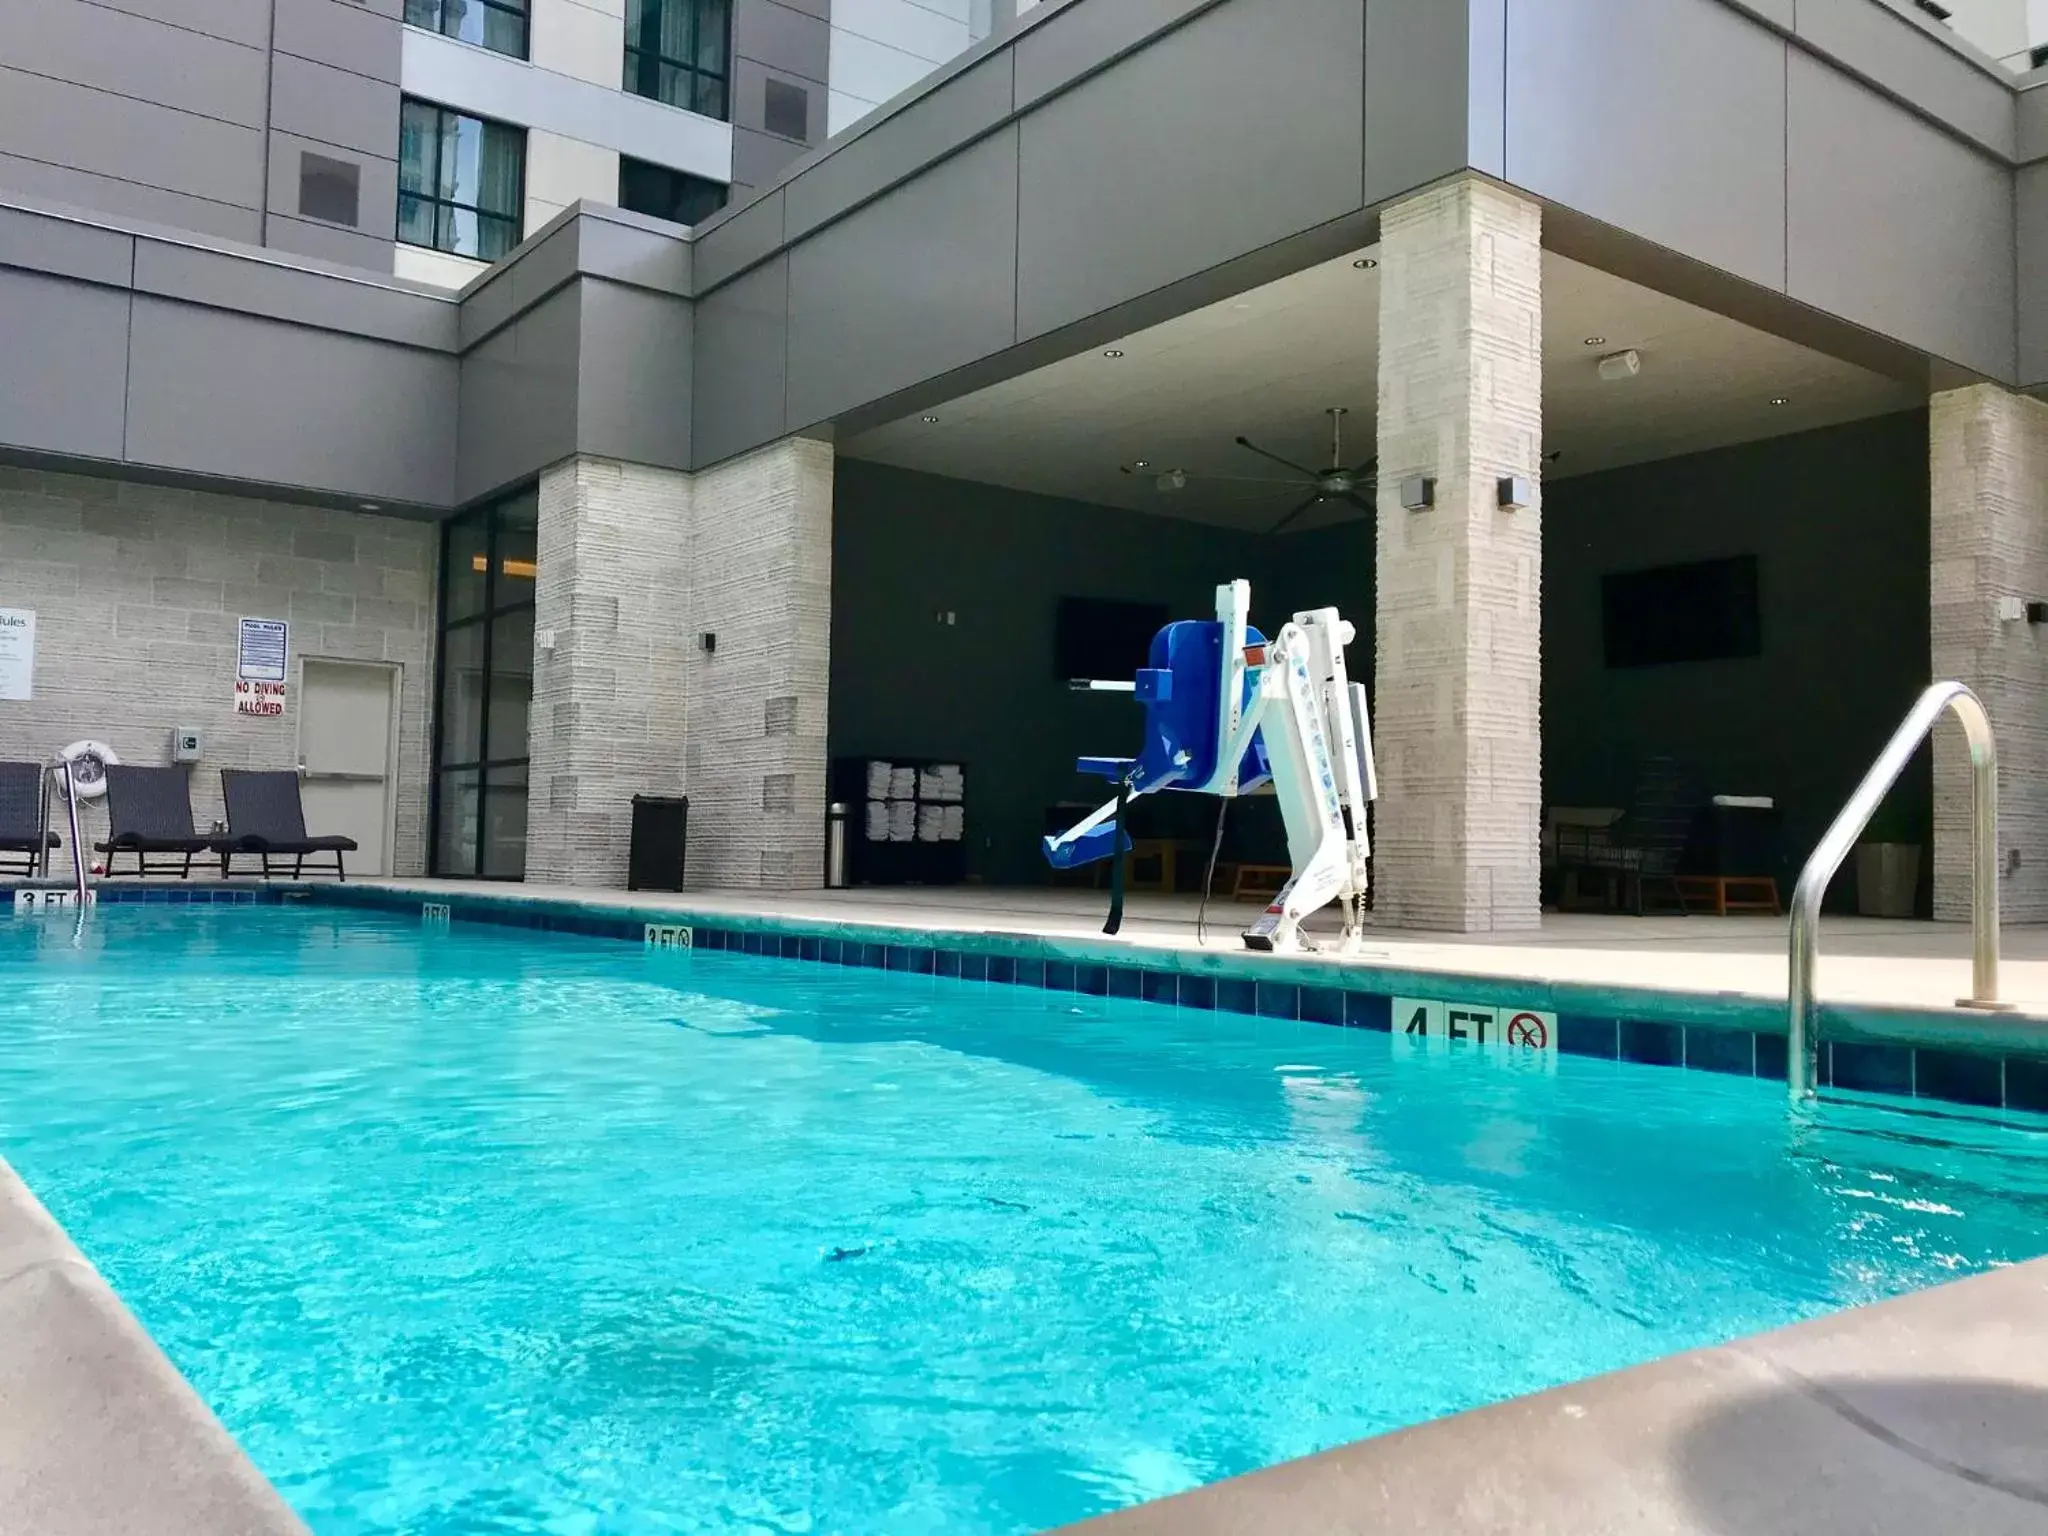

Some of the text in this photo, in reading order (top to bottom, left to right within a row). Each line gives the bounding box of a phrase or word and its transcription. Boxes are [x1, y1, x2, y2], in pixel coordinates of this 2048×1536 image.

[0, 616, 26, 627] ules
[235, 682, 285, 696] NO DIVING
[238, 701, 282, 715] ALLOWED
[45, 892, 67, 905] FT
[661, 929, 675, 944] FT
[1449, 1010, 1493, 1045] FT
